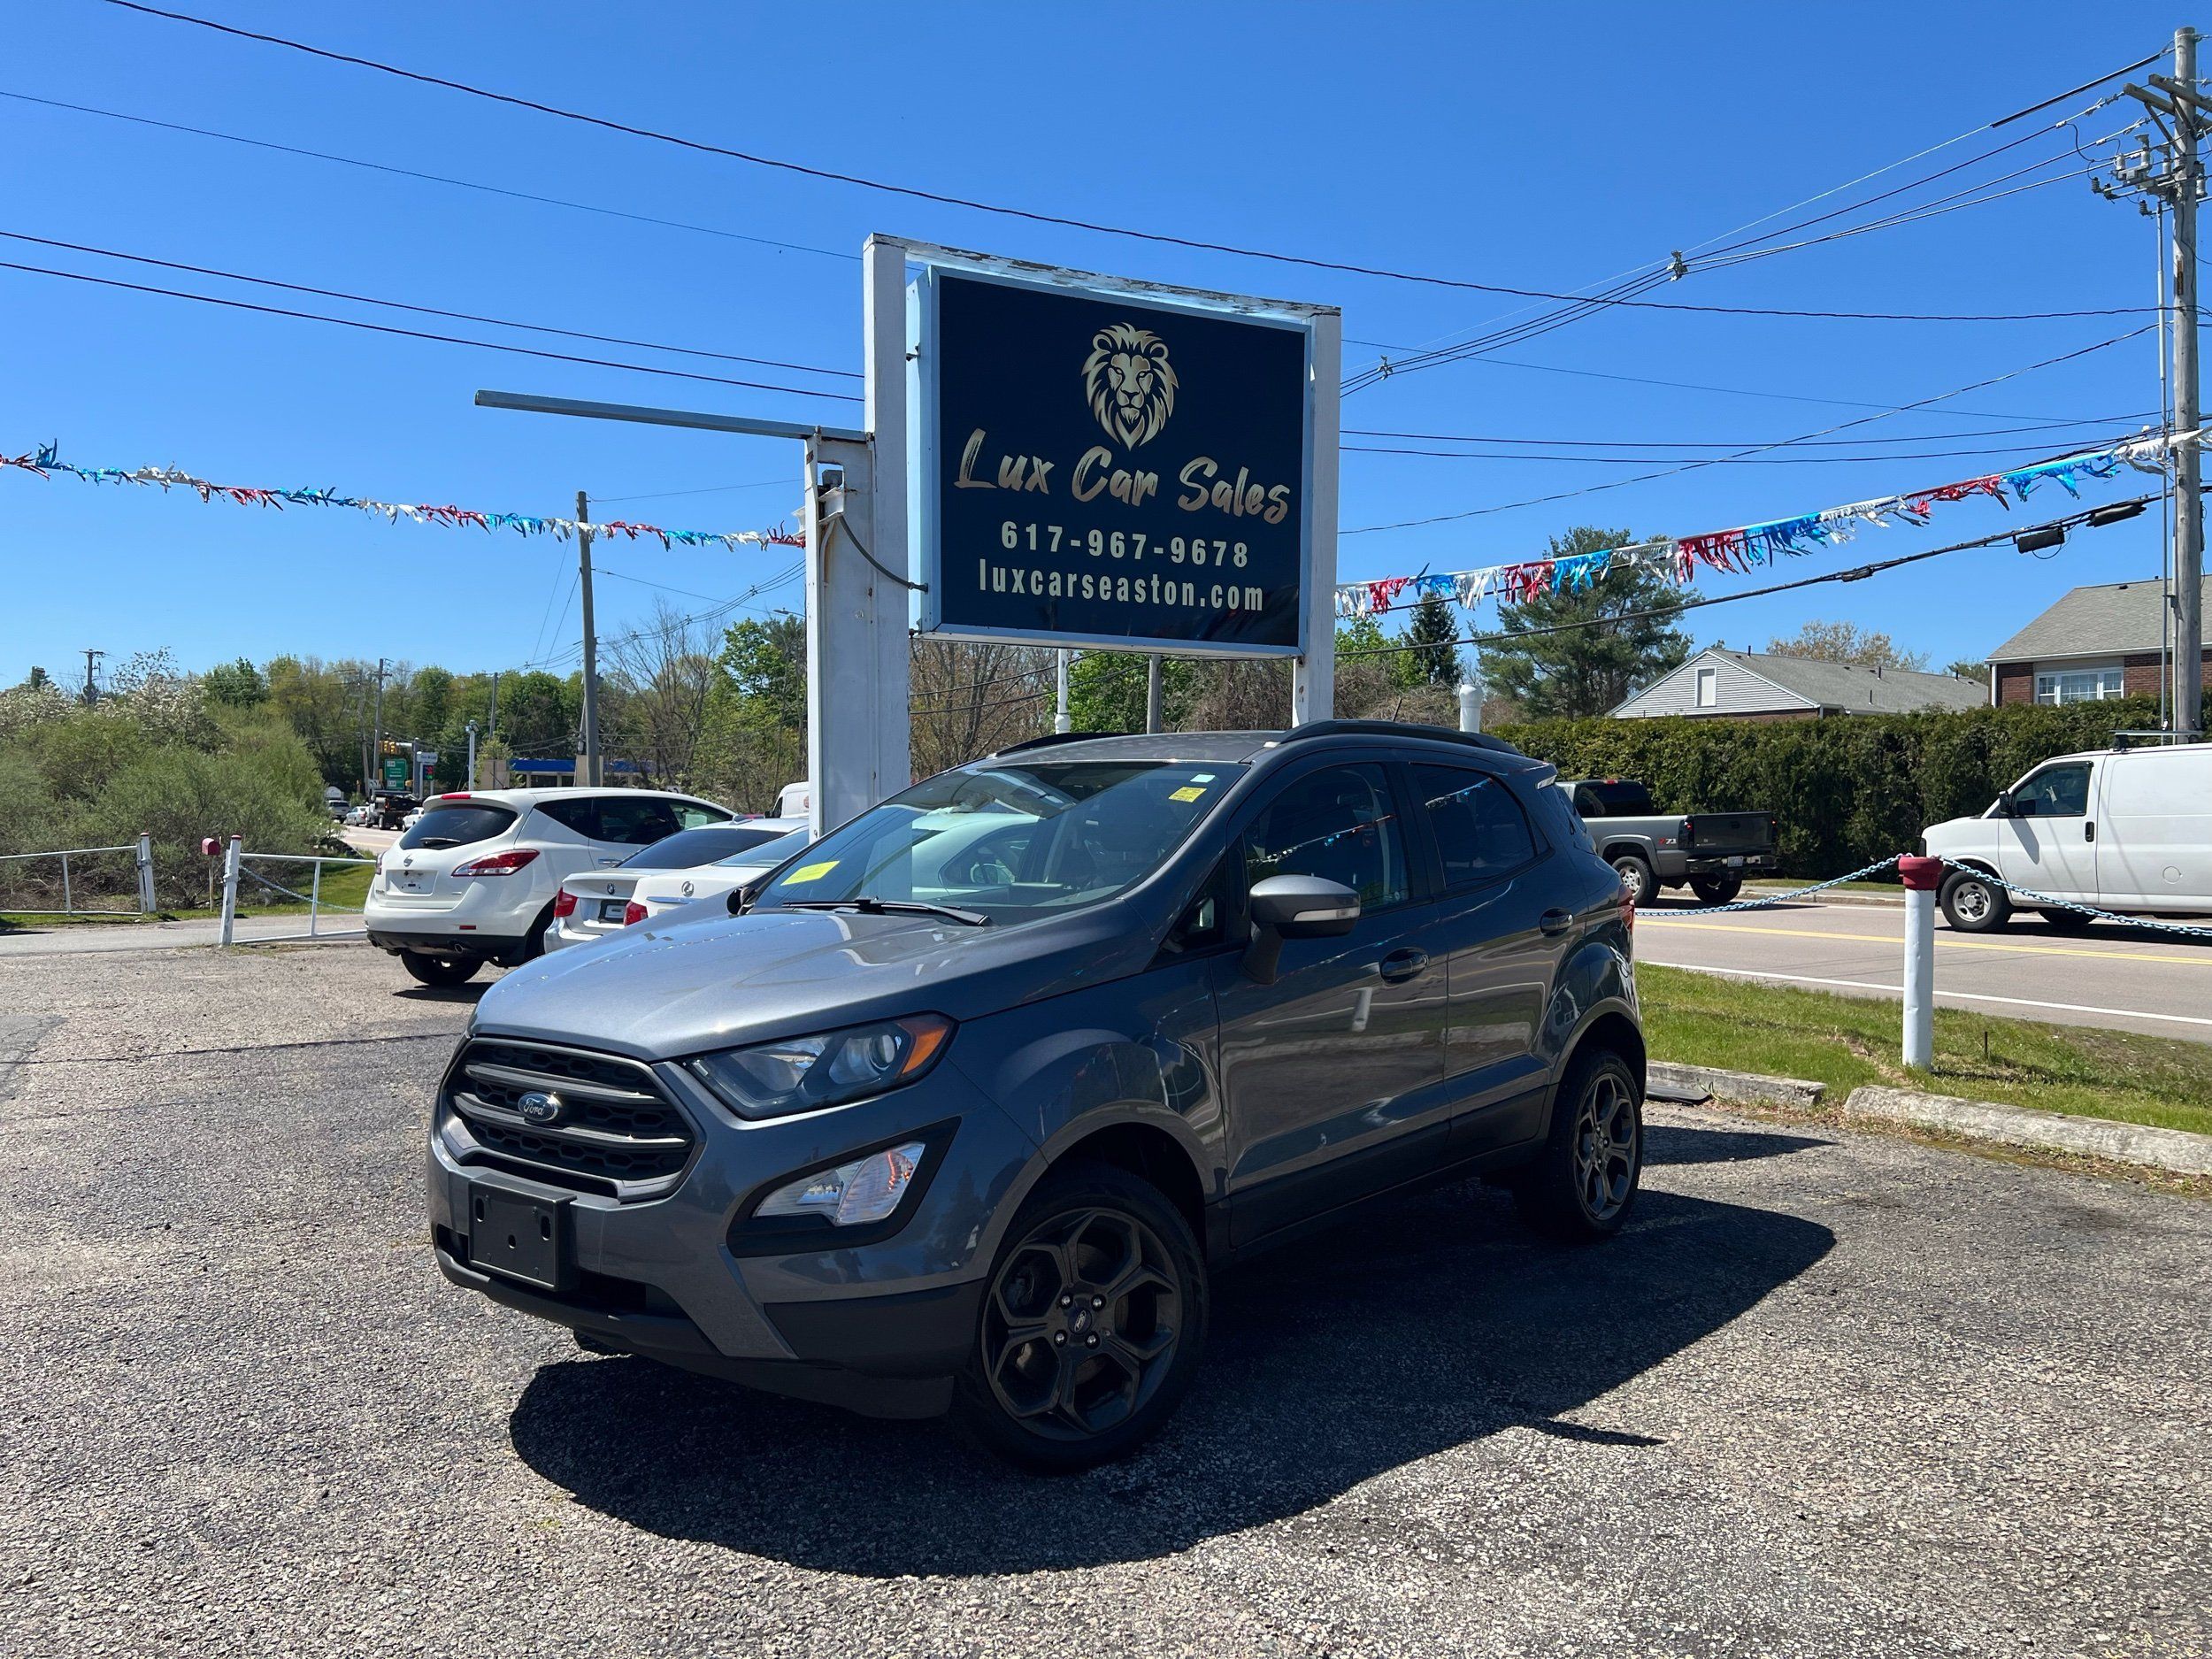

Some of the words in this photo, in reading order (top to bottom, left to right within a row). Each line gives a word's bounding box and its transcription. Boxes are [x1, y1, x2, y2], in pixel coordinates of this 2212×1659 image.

[955, 429, 1055, 494] Lux
[1072, 446, 1158, 507] Car
[1178, 457, 1290, 525] Sales
[1002, 520, 1248, 567] 617-967-9678
[979, 558, 1263, 611] luxcarseaston.com
[523, 1097, 545, 1117] Ford
